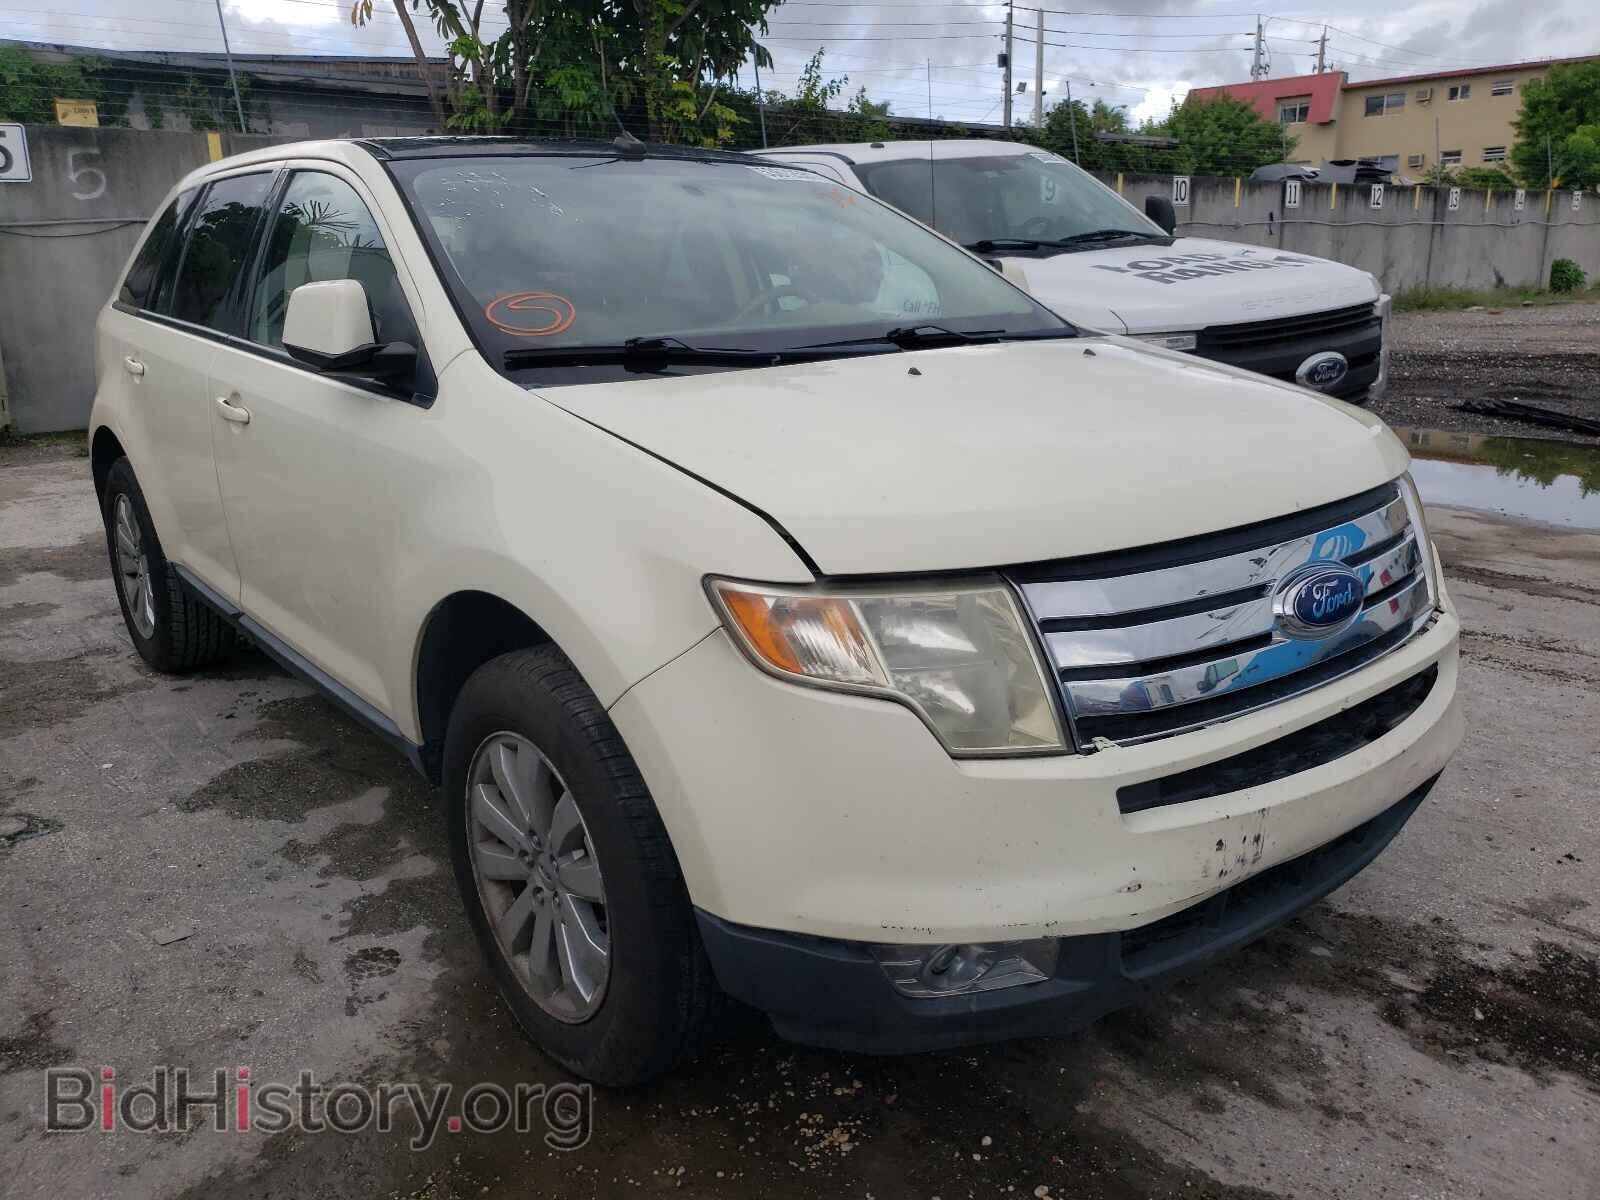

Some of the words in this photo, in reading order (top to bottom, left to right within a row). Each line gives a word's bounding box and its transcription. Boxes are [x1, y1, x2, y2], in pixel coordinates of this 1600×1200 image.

[66, 147, 107, 200] 5
[1174, 180, 1188, 202] 10
[1287, 182, 1298, 204] 11
[1371, 186, 1383, 206] 12
[1313, 361, 1340, 382] Ford
[1313, 579, 1353, 618] Ford
